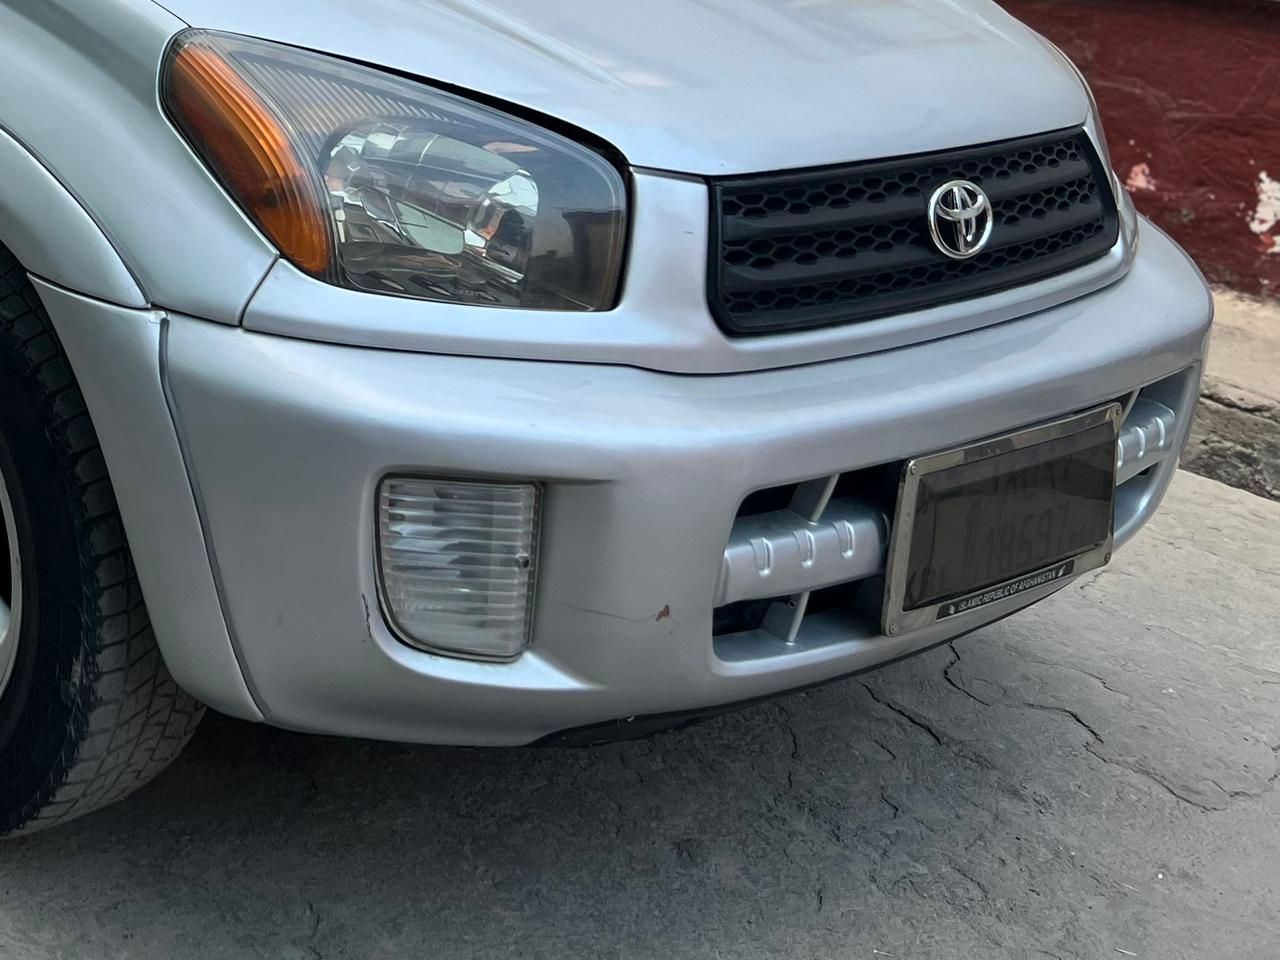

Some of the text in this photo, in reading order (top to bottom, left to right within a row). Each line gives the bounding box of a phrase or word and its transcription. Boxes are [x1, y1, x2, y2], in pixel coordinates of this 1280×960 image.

[958, 570, 1057, 611] ISLAMIC REPUBLIC OF AFGHANISTAN
